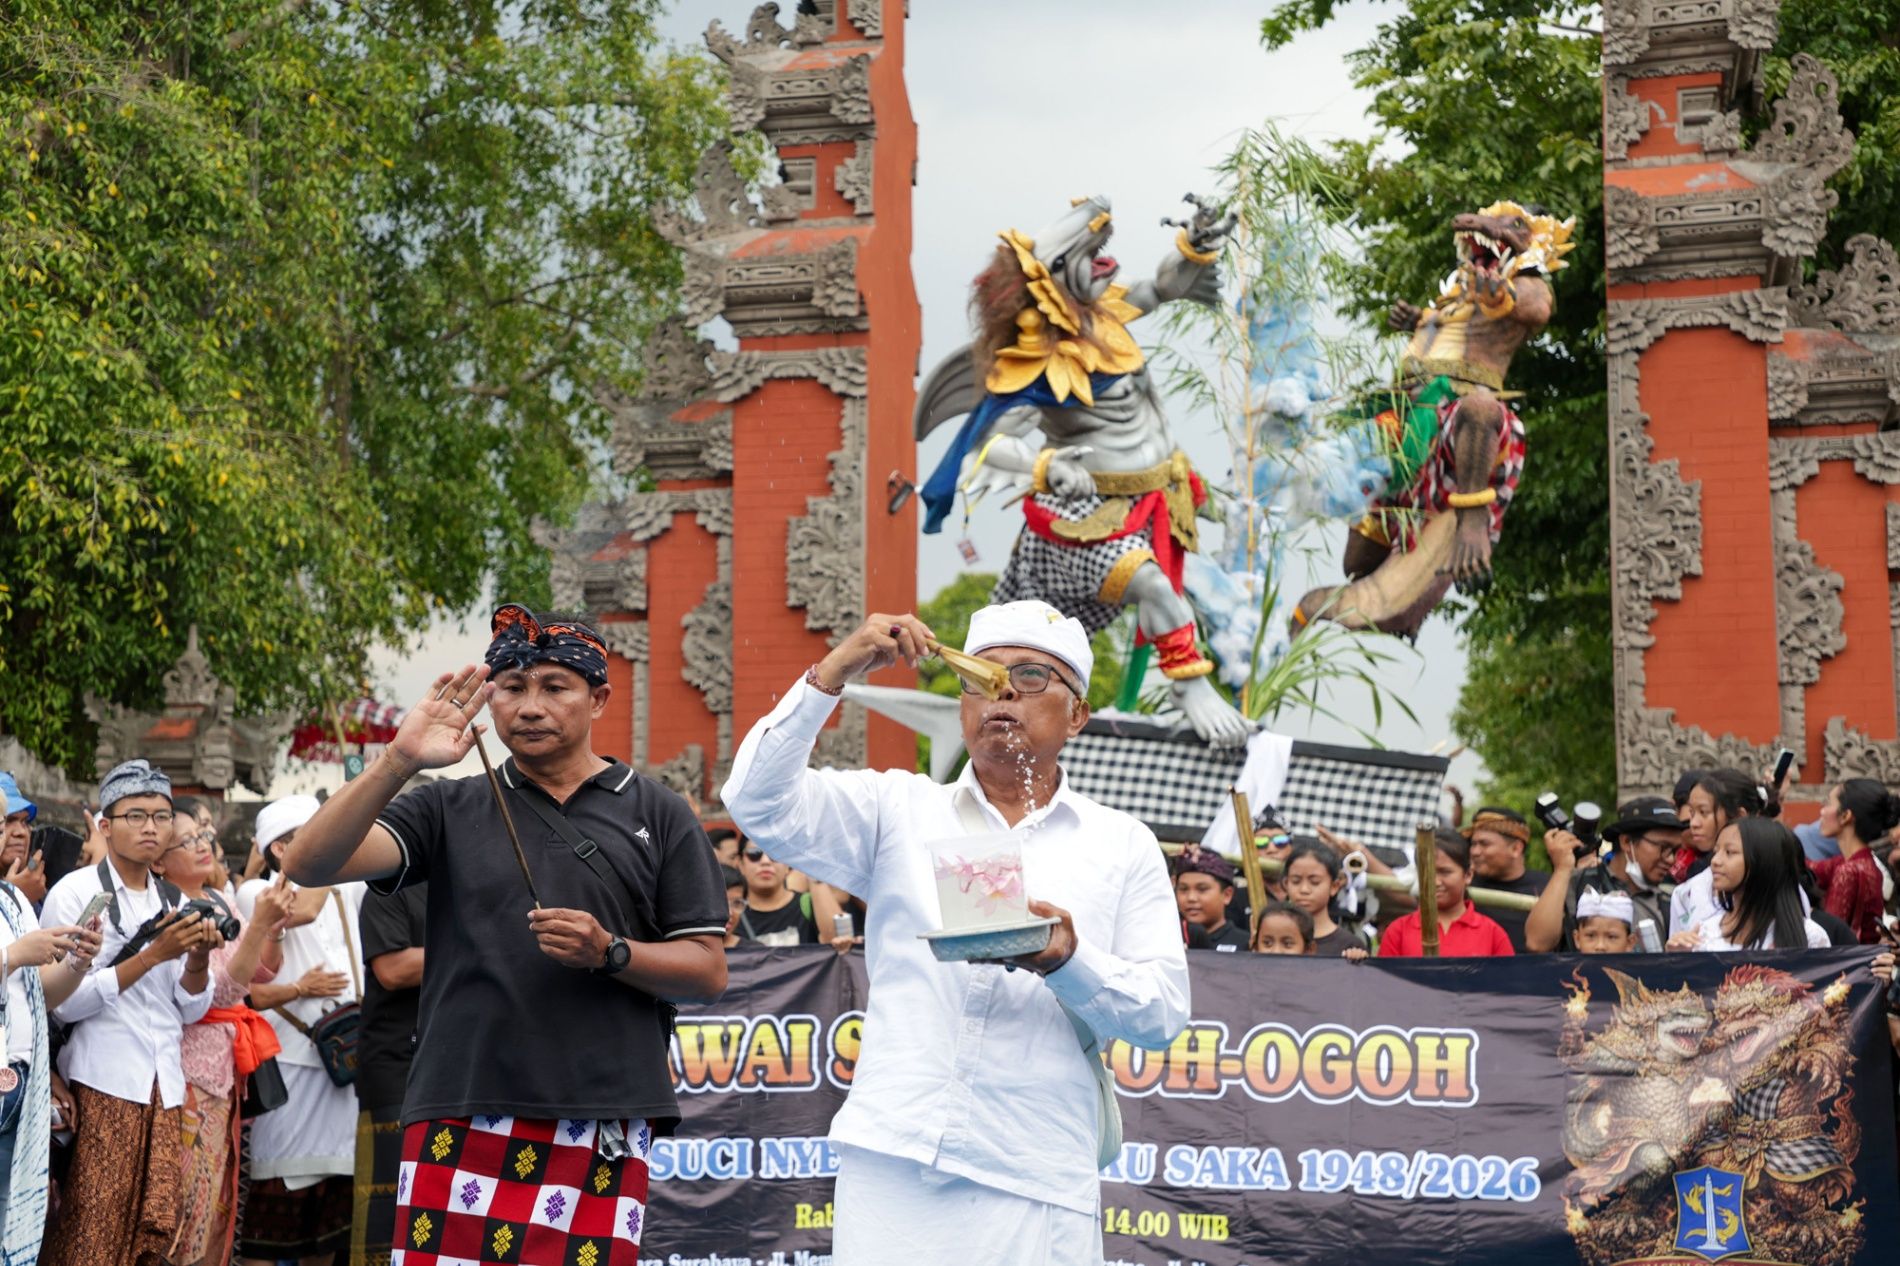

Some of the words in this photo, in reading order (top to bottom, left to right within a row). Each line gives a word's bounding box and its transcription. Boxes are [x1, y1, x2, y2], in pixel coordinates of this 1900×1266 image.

[1101, 1022, 1479, 1107] OH-OGOH
[649, 1137, 754, 1180] SUCI
[1163, 1145, 1291, 1190] SAKA
[1297, 1149, 1541, 1201] 1948/2026
[1104, 1206, 1170, 1237] 14.00
[1177, 1213, 1230, 1241] WIB
